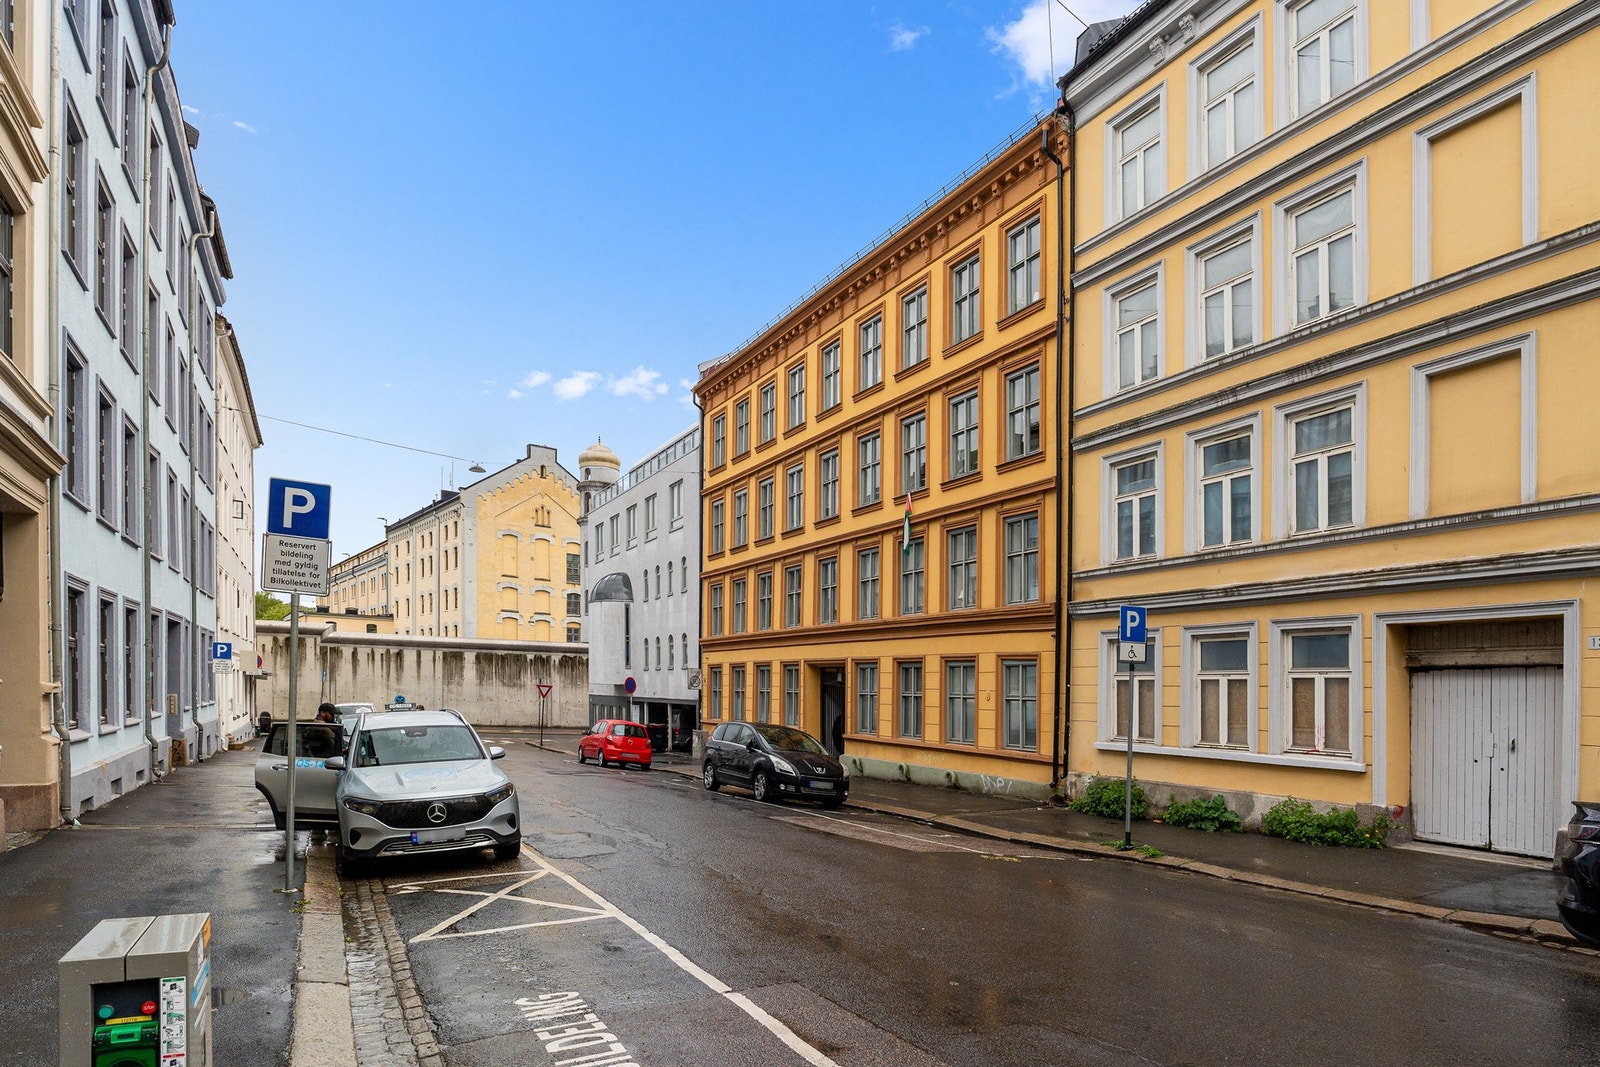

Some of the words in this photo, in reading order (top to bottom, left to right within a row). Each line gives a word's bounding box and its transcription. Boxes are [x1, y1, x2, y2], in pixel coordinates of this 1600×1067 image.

[283, 486, 316, 529] P
[279, 540, 316, 550] Reservert
[280, 550, 314, 561] bildeling
[294, 561, 319, 571] gyldig
[272, 568, 306, 577] tillatelse
[309, 571, 320, 579] for
[270, 577, 321, 588] Bilkollektivet
[1126, 610, 1140, 637] P
[217, 644, 228, 657] P
